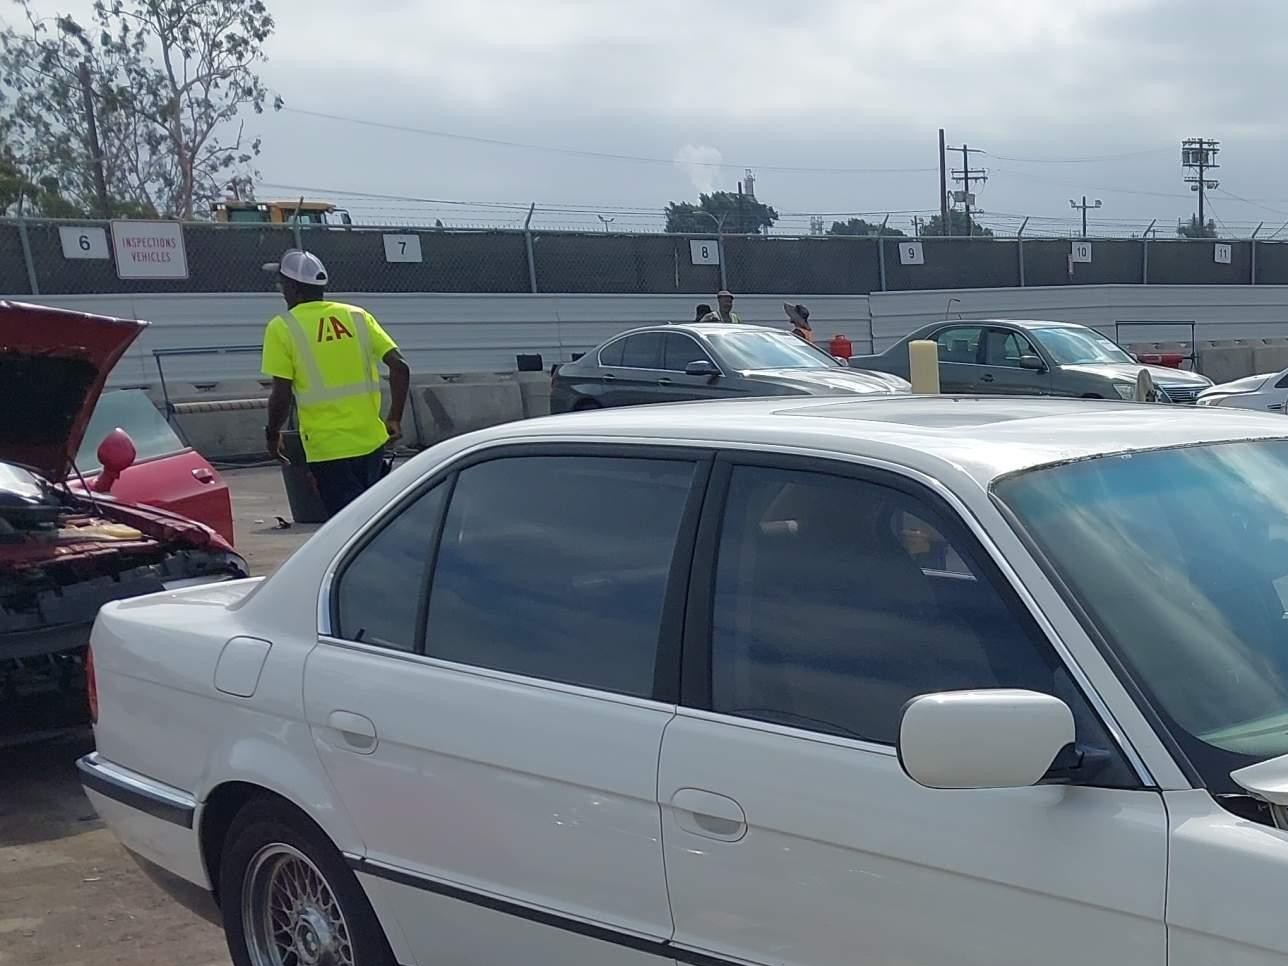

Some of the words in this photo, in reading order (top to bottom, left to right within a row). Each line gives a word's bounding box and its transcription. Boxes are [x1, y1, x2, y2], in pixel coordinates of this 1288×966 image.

[78, 235, 91, 251] 6
[121, 236, 177, 249] INSPECTIONS
[397, 241, 407, 255] 7
[131, 251, 171, 263] VEHICLES
[701, 246, 709, 259] 8
[908, 247, 915, 259] 9
[1077, 246, 1087, 257] 10
